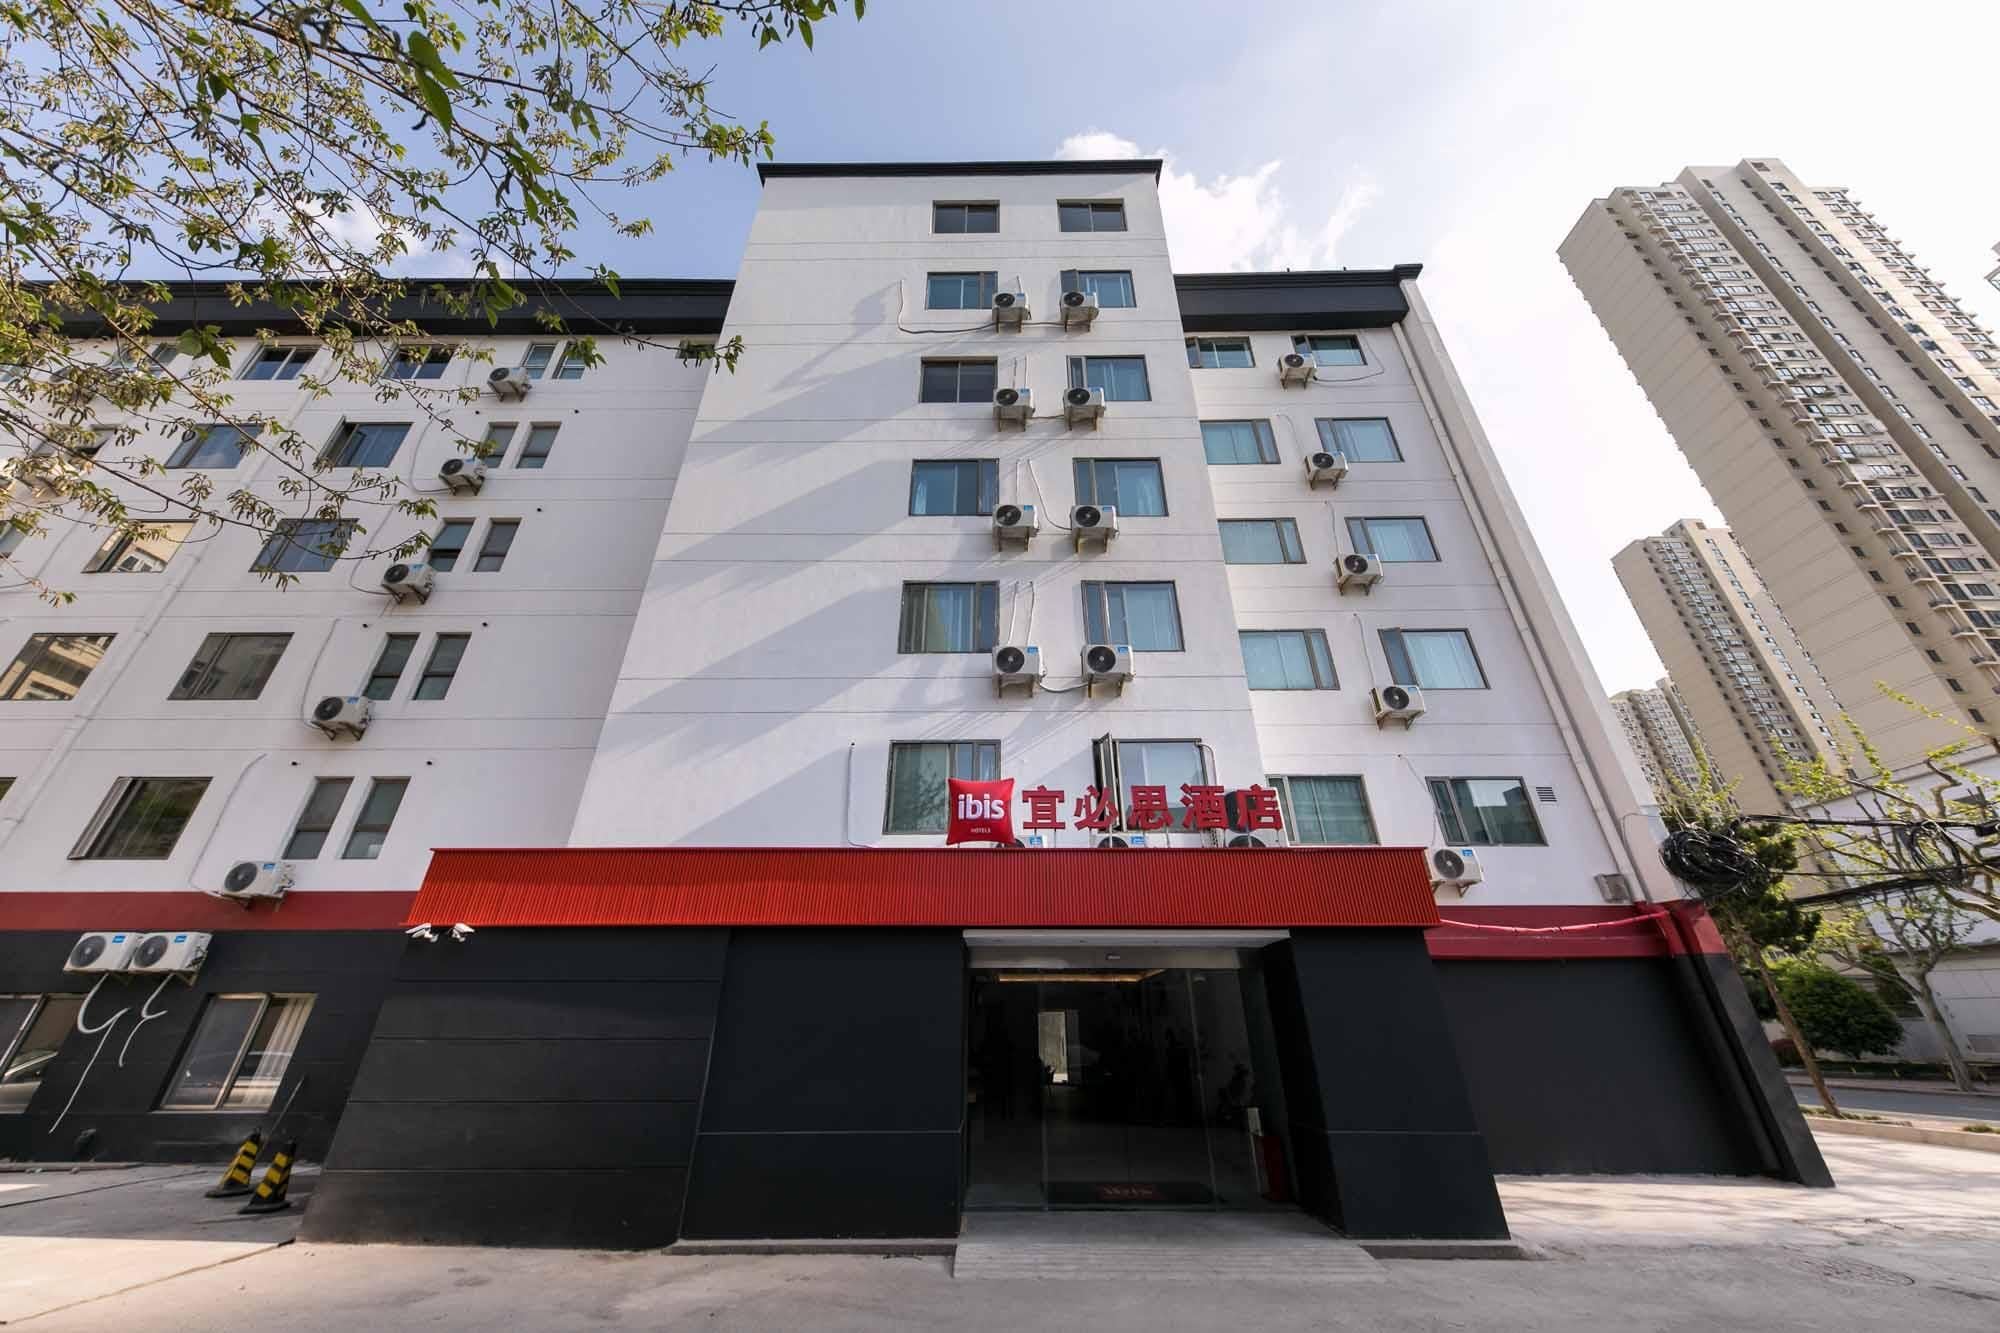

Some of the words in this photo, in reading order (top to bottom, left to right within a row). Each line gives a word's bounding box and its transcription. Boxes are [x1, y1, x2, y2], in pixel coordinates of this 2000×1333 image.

[958, 793, 1005, 819] ibis
[1021, 783, 1283, 830] 宜必思酒店
